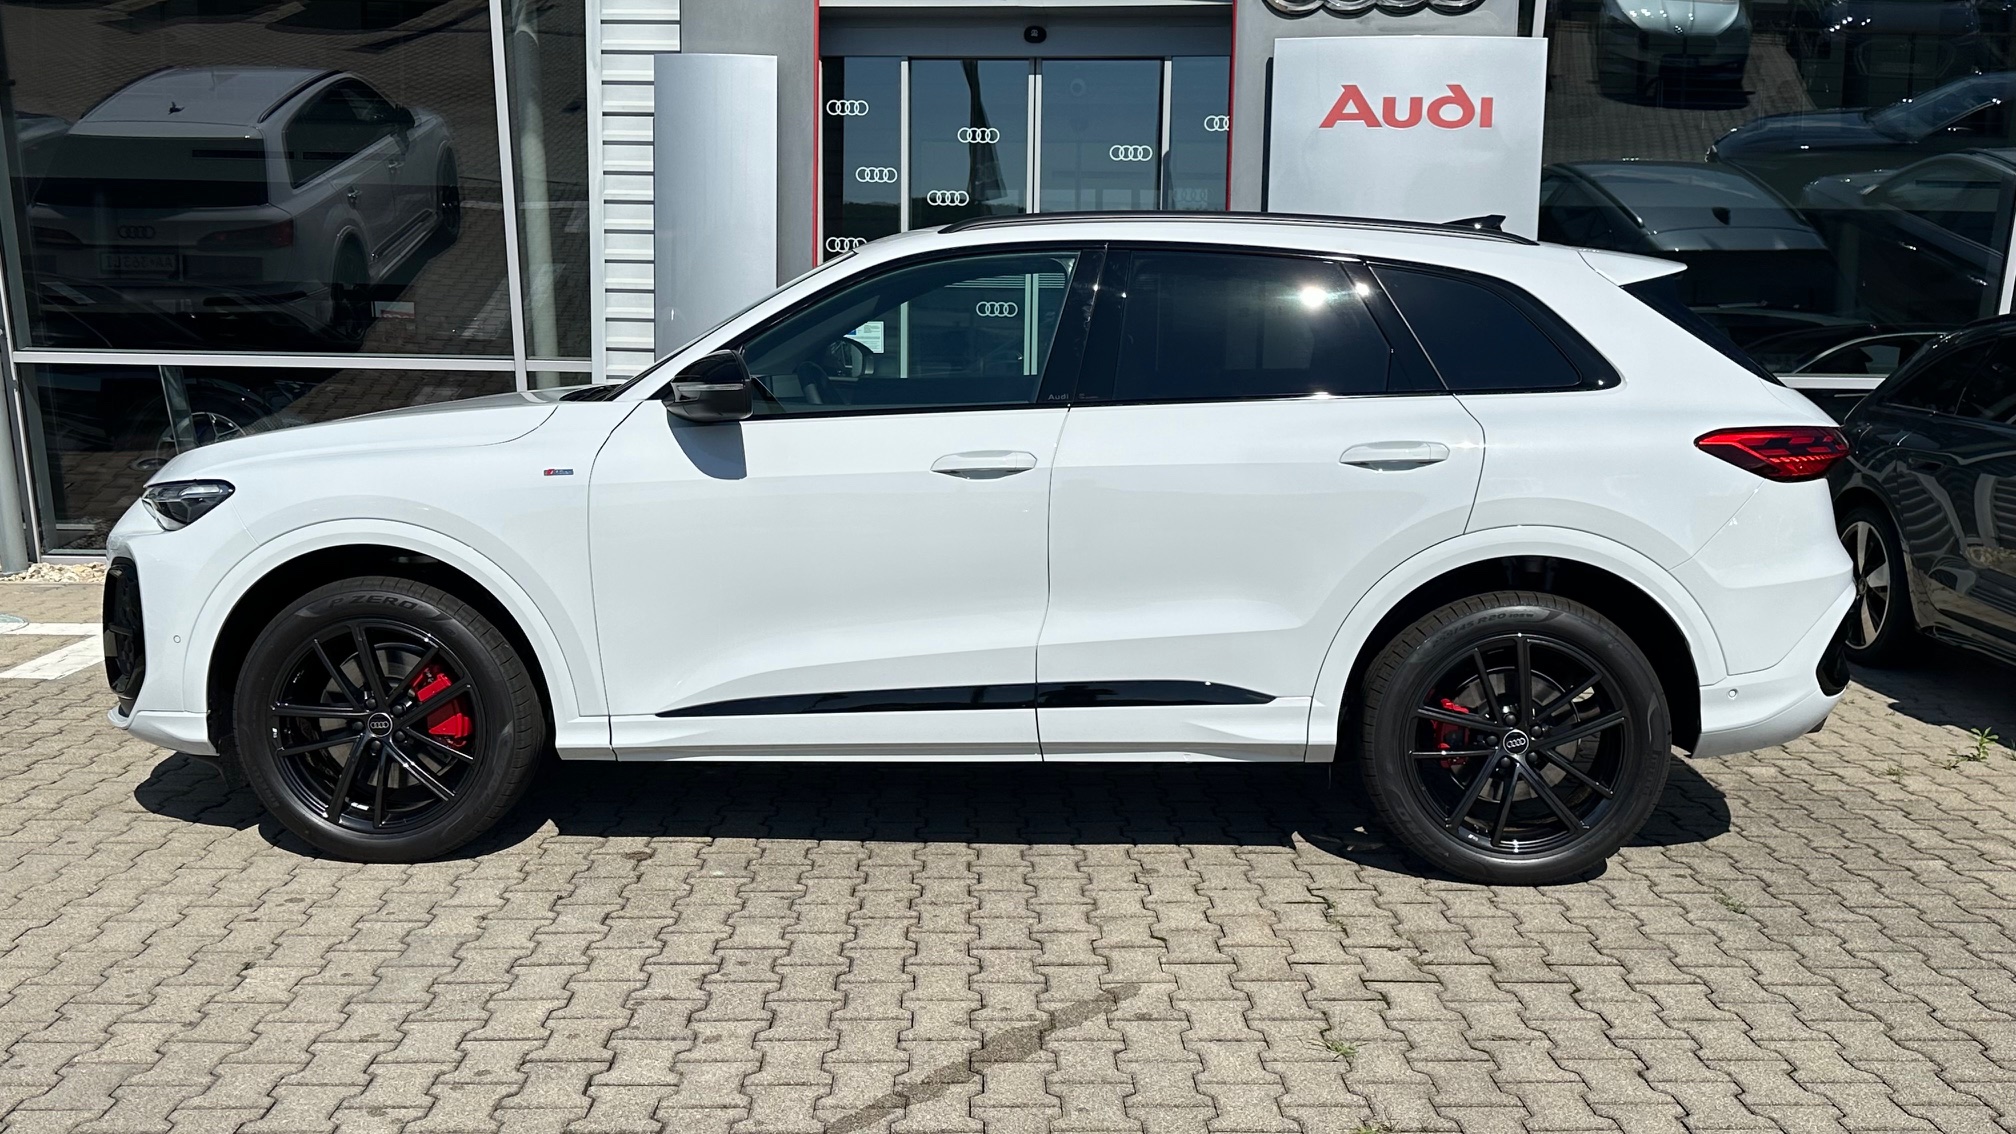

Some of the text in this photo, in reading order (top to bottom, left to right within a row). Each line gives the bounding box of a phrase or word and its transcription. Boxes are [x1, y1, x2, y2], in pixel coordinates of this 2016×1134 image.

[1319, 84, 1494, 129] Audi
[329, 595, 418, 609] P ZERO
